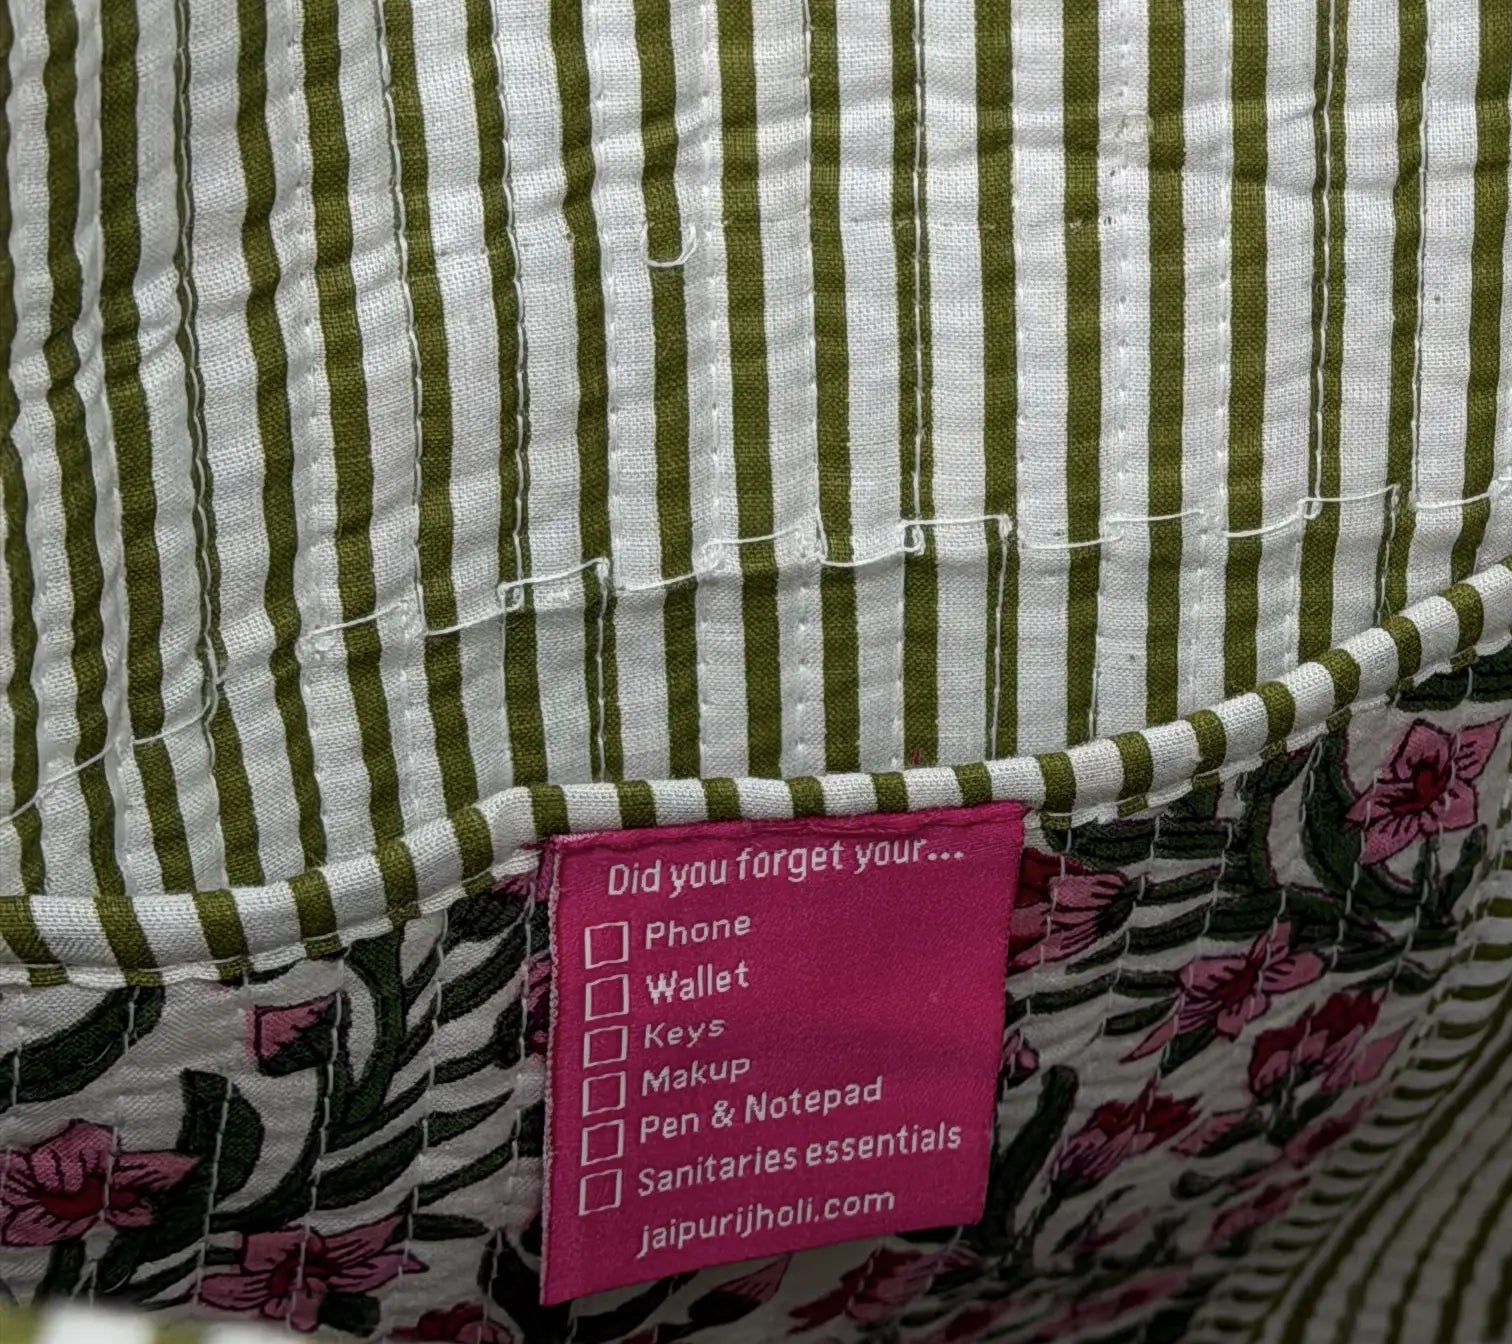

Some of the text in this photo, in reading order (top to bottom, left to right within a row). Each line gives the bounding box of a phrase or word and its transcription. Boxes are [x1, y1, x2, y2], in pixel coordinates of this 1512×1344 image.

[608, 838, 965, 899] Did you forget your...
[645, 914, 751, 950] Phone
[645, 959, 750, 1005] Wallet
[643, 1018, 727, 1049] Keys
[641, 1057, 751, 1097] Makup
[639, 1075, 884, 1144] Pen & Notepad
[637, 1120, 963, 1197] Sanitaries essentials
[635, 1189, 896, 1260] jaipurijholi.com
